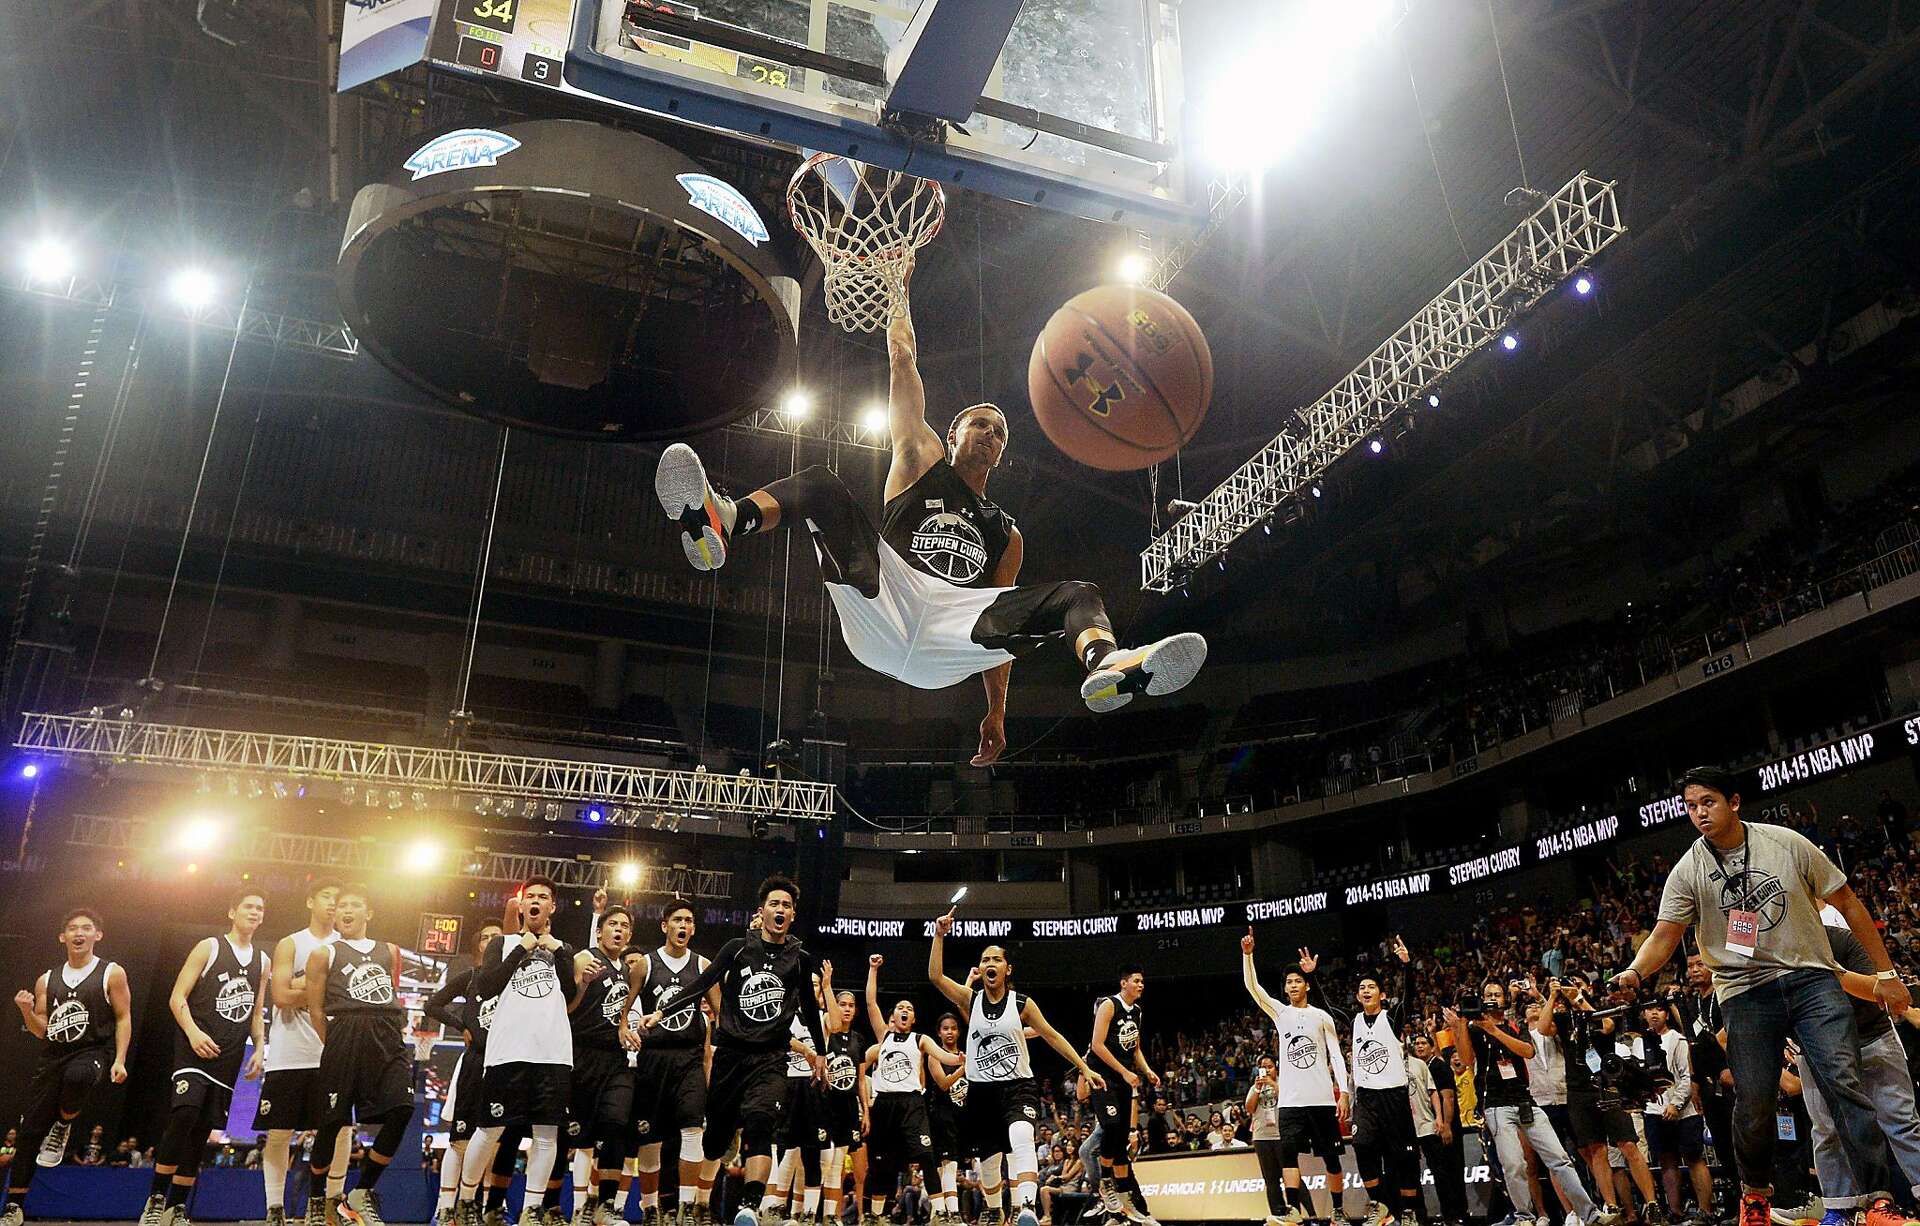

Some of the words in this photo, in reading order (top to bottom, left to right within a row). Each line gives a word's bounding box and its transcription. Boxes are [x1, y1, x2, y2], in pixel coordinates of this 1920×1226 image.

[481, 47, 495, 66] 0
[534, 60, 549, 80] 3
[418, 144, 493, 177] ARENA
[912, 534, 959, 551] STEPHEN
[960, 542, 988, 567] CURRY
[1706, 656, 1732, 675] 416
[1758, 754, 1810, 791] 2014-15
[1810, 744, 1843, 776] NBA
[1841, 733, 1874, 765] MVP
[1639, 794, 1689, 828] STEPHE
[1537, 830, 1573, 860] 2014-15
[1573, 822, 1597, 848] NBA
[1595, 815, 1619, 841] MVP
[1449, 857, 1490, 886] STEPHEN
[1489, 846, 1521, 874] CURRY
[1345, 884, 1384, 905] 2014-15
[1384, 878, 1408, 898] NBA
[1408, 873, 1431, 895] MVP
[1757, 879, 1784, 900] CURRY
[1246, 898, 1292, 922] STEPHEN
[1293, 892, 1328, 914] CURRY
[434, 919, 458, 932] 1:00
[867, 921, 905, 937] CURRY
[964, 921, 987, 937] NBA
[989, 921, 1012, 937] MVP
[1032, 919, 1081, 937] STEPHEN
[1082, 916, 1119, 936] CURRY
[1137, 911, 1176, 930] 2014-15
[1177, 909, 1200, 927] NBA
[1201, 907, 1225, 926] MVP
[425, 931, 451, 952] 24
[511, 975, 539, 990] STEPHEN
[739, 993, 766, 1008] STEPHEN
[977, 1054, 1001, 1069] STEPHEN
[1000, 1046, 1019, 1059] CURRY
[1161, 1182, 1205, 1196] ARMOUR
[1224, 1178, 1265, 1194] UNDER
